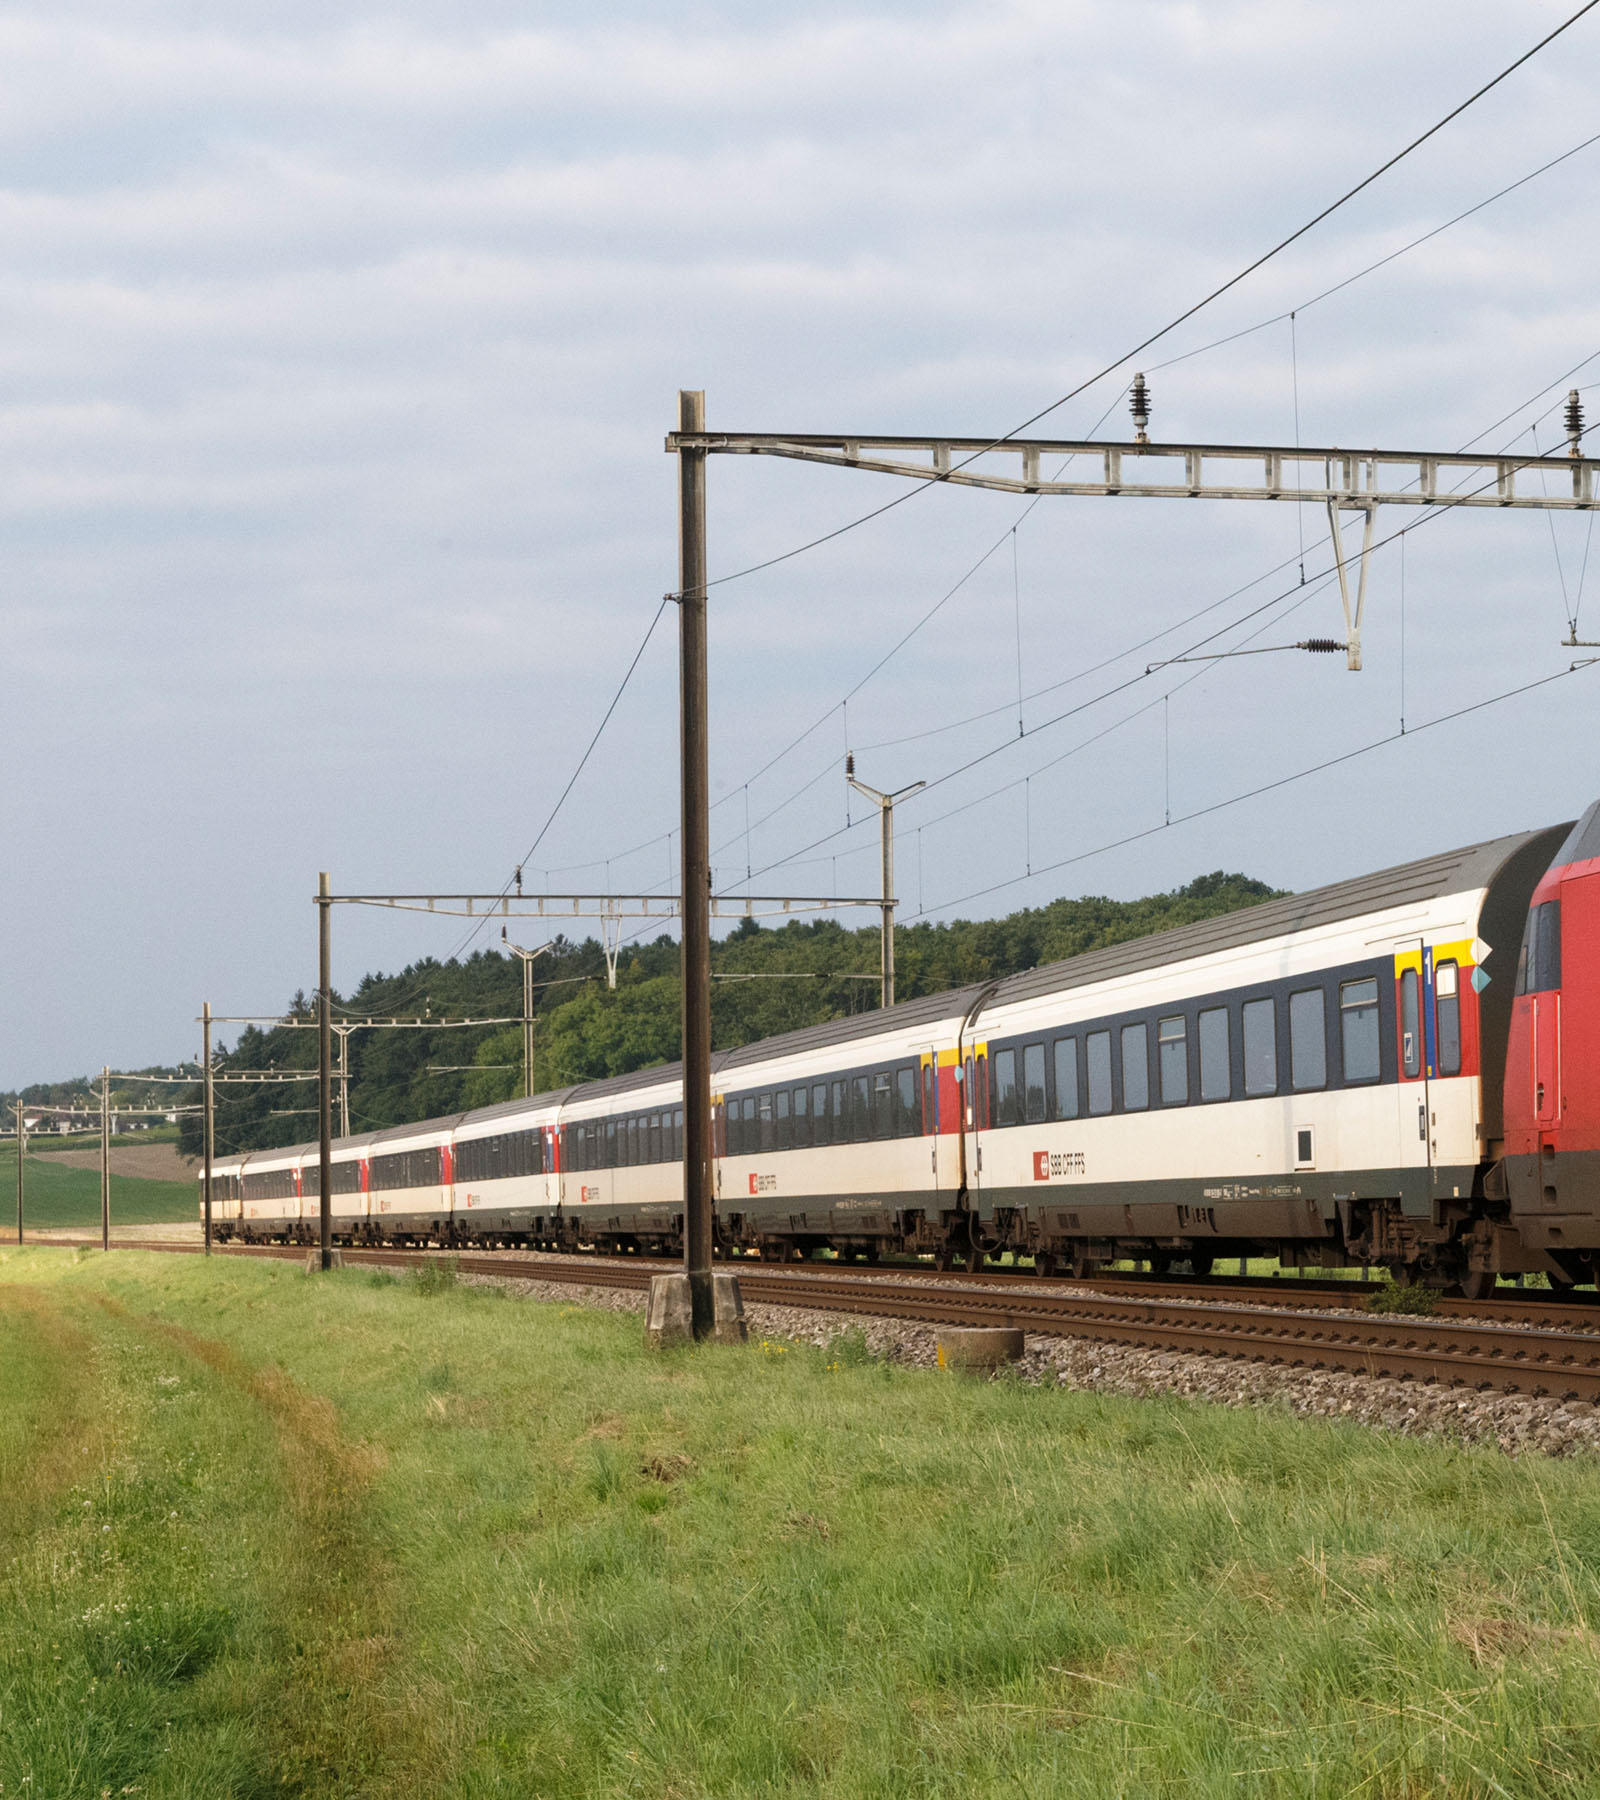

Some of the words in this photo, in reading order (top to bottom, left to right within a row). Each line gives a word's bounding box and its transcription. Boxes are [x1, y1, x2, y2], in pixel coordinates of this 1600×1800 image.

[1424, 951, 1432, 985] 1
[1050, 1153, 1062, 1176] SBB
[1062, 1152, 1073, 1176] CFF
[1074, 1151, 1086, 1175] FFS
